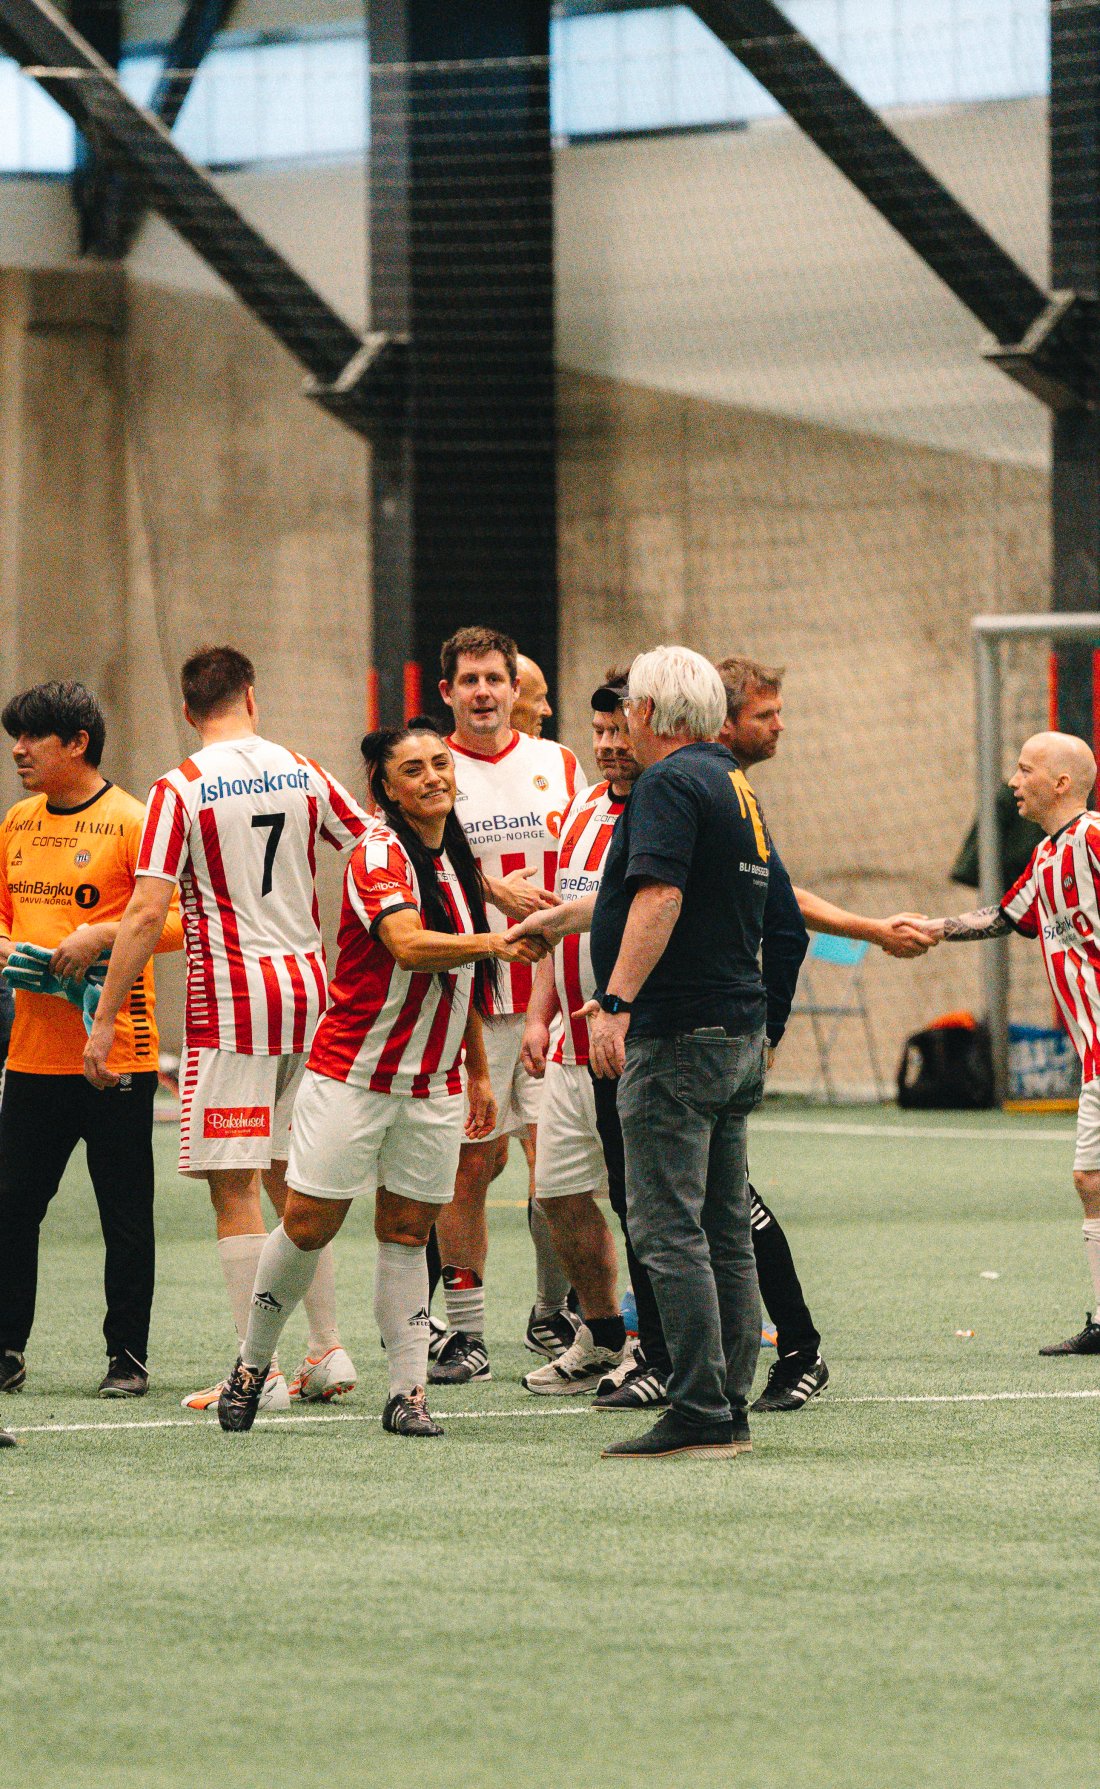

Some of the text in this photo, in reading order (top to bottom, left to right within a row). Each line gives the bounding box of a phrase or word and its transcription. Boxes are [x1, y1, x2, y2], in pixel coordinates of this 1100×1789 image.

[200, 768, 309, 803] Ishavskraft
[75, 820, 124, 837] HARILA
[463, 811, 543, 834] areBank
[32, 836, 78, 848] CONSTO
[468, 829, 545, 846] NORD-NORGE
[251, 812, 285, 897] 7
[739, 862, 751, 872] BLI
[8, 880, 74, 898] astinBáŋku
[560, 876, 601, 892] areBan
[20, 896, 72, 906] DAVVI-NORGA
[207, 1112, 266, 1129] Bakehuset
